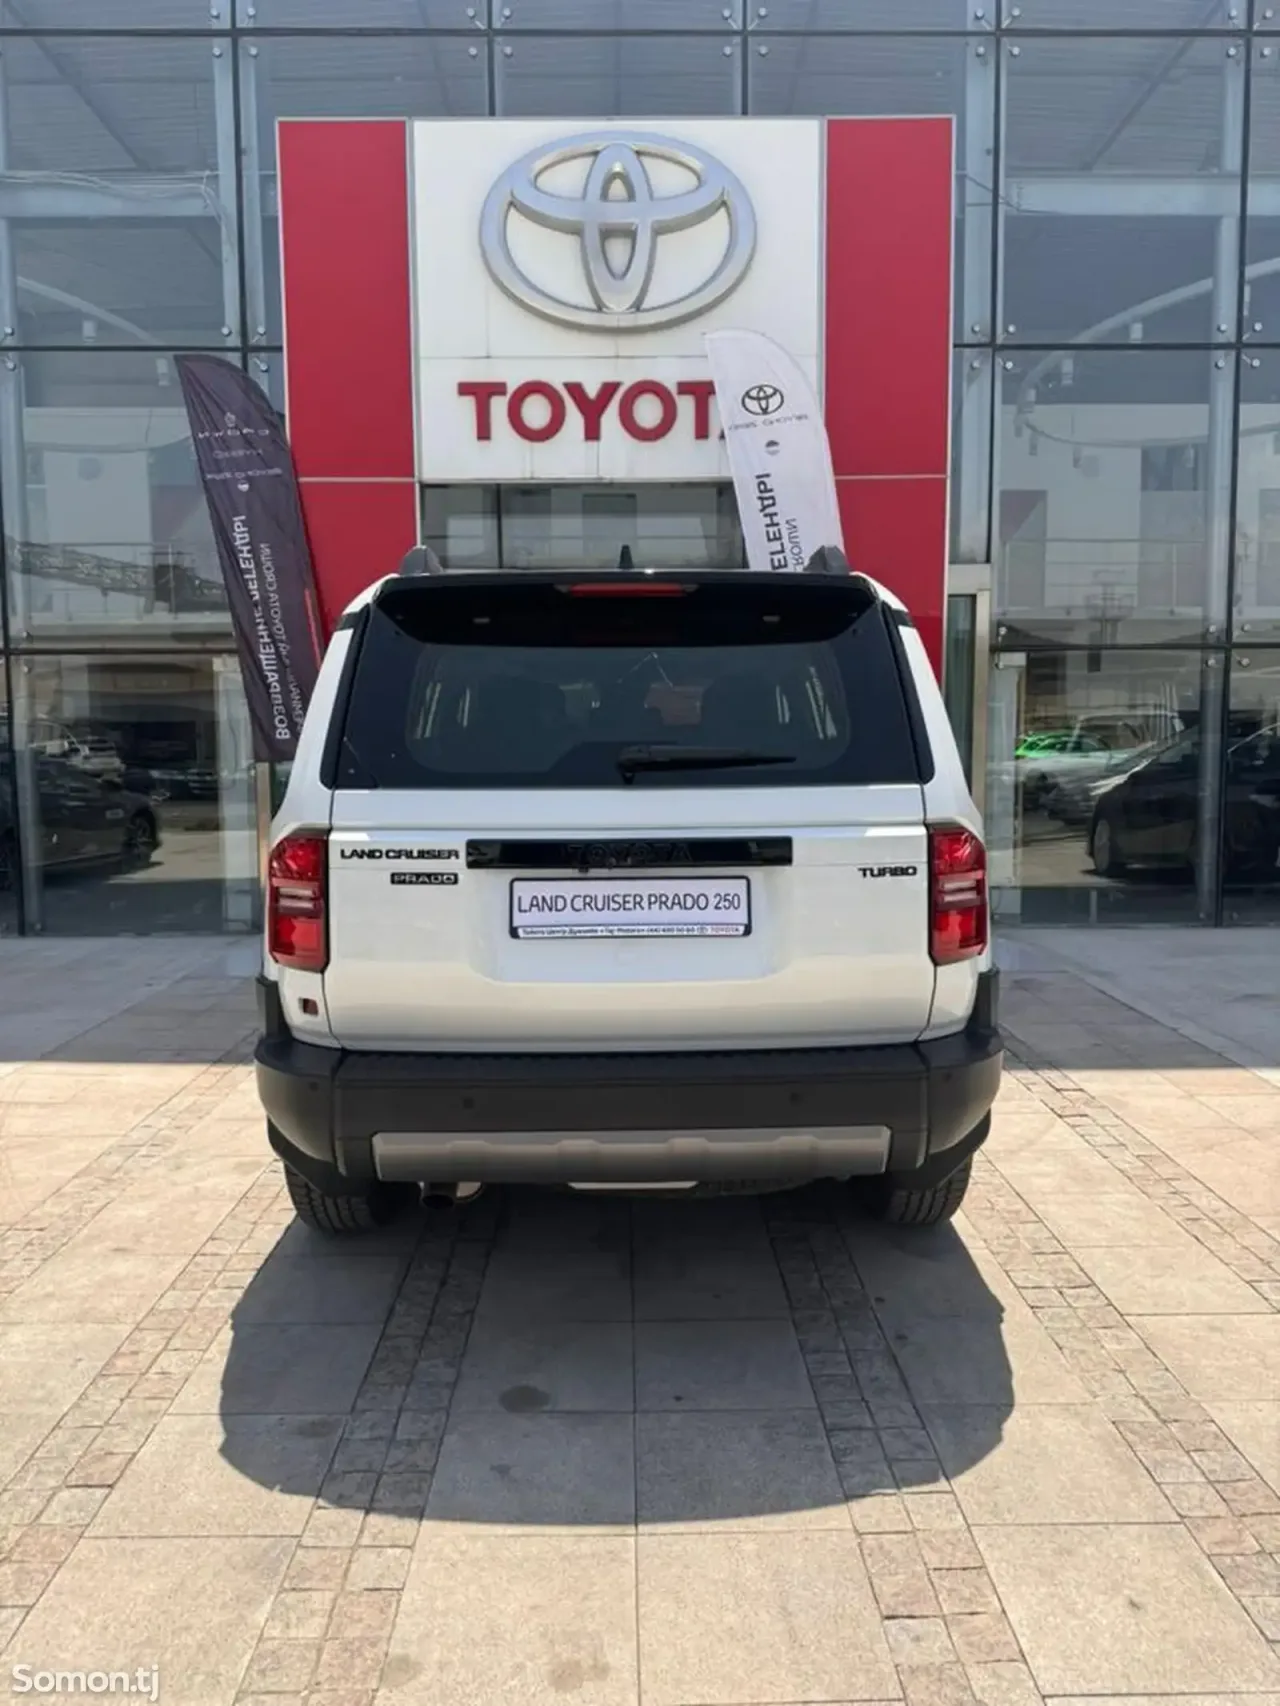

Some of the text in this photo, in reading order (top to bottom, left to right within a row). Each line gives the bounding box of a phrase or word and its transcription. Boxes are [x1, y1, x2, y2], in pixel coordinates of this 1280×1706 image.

[457, 380, 724, 442] TOYOT
[340, 849, 459, 859] LAND CRUISER
[858, 866, 917, 878] TURBO
[394, 875, 455, 884] PRADO
[518, 893, 741, 913] LAND CRUISER PRADO 250
